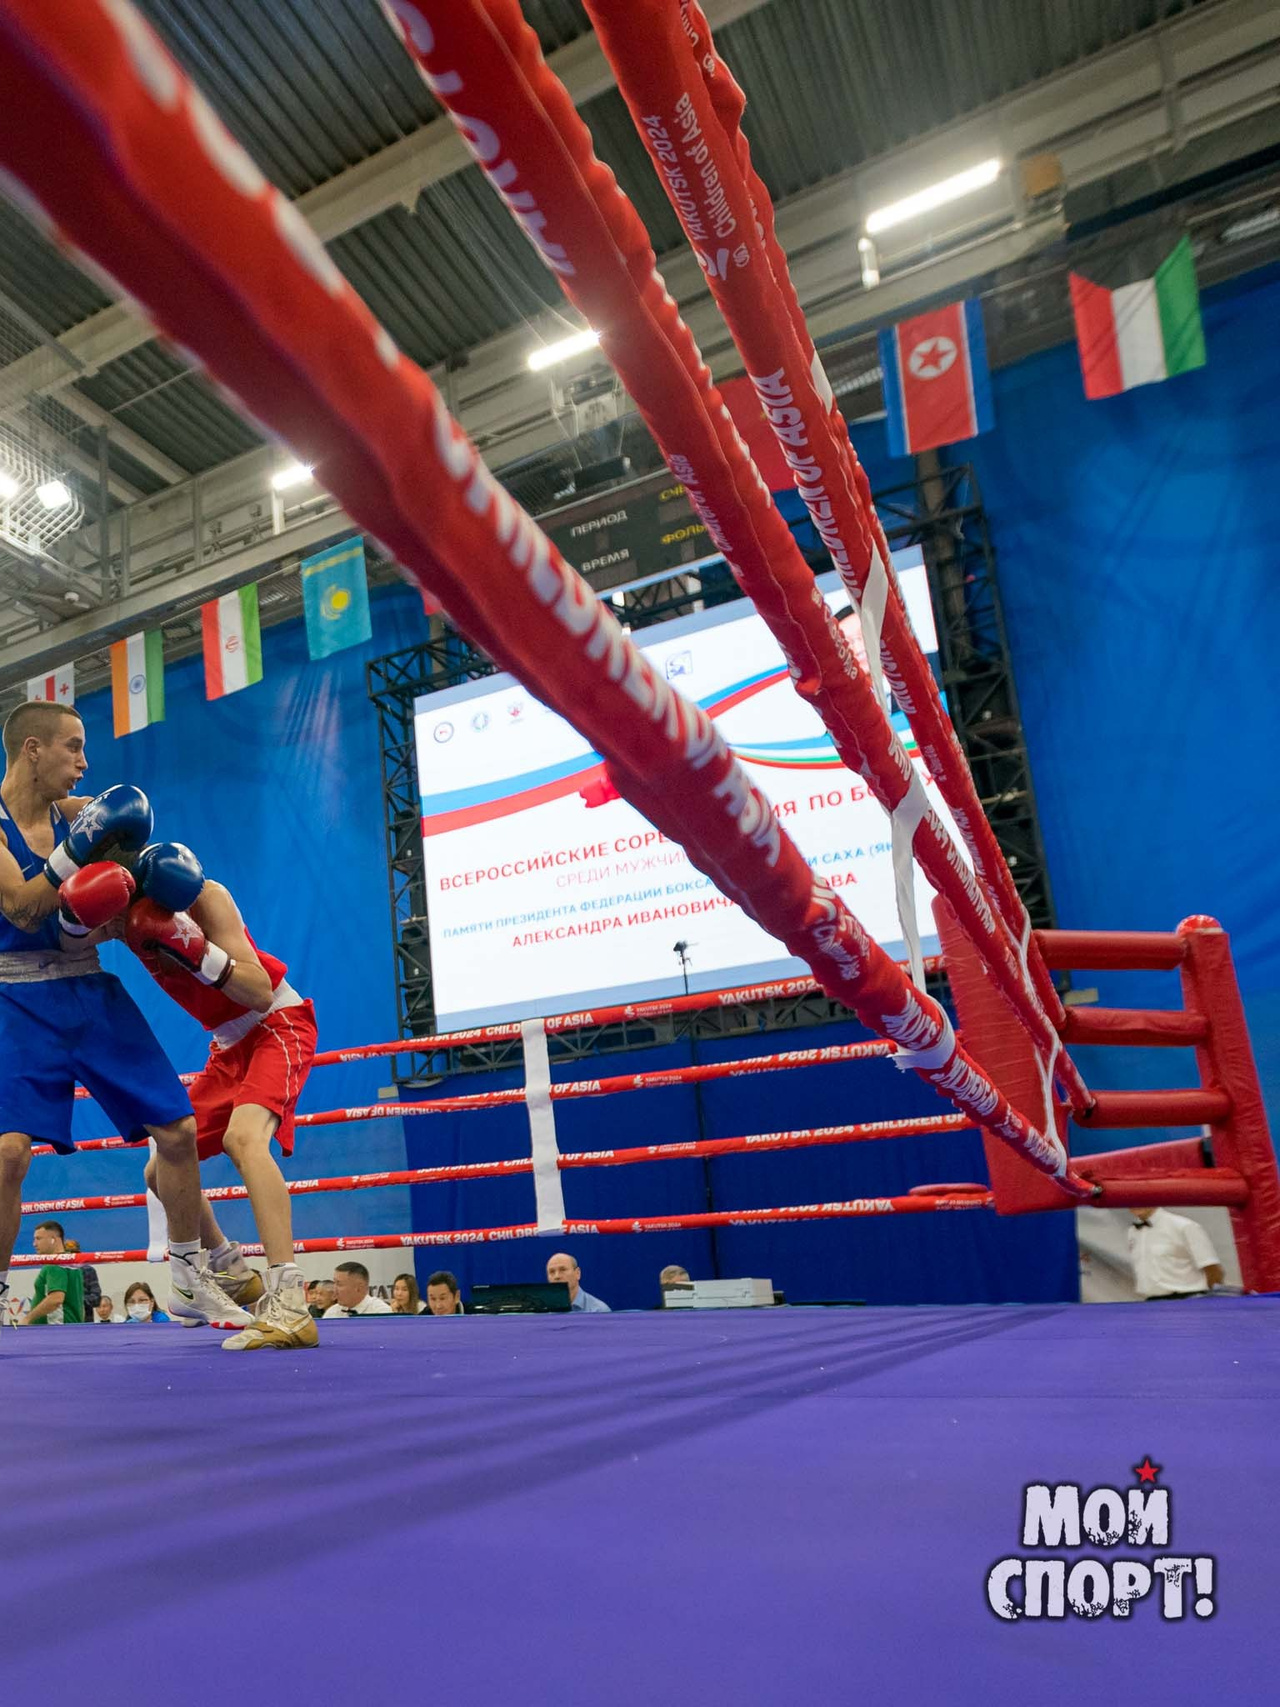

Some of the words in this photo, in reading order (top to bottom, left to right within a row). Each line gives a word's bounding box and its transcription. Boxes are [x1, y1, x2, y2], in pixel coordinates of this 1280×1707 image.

[674, 91, 701, 142] Asia
[641, 116, 677, 162] 2024
[699, 159, 736, 237] Children
[750, 366, 808, 445] ASIA
[571, 509, 628, 537] ПЕРИОД
[582, 548, 630, 573] ВРЕМЯ
[440, 842, 609, 891] ВСЕРОССИЙСКИЕ
[555, 866, 611, 889] СРЕДИ
[443, 920, 493, 938] ПАМЯТИ
[496, 904, 578, 929] ПРЕЗИДЕНТА
[580, 887, 663, 912] ФЕДЕРАЦИИ
[822, 848, 865, 864] САХА
[512, 918, 622, 948] АЛЕКСАНДРА
[718, 985, 783, 1005] YAKUTSK
[547, 1017, 563, 1029] OF
[563, 1012, 595, 1026] ASIA
[821, 1043, 893, 1060] YAKUTSK
[571, 1080, 601, 1093] ASIA
[66, 1199, 86, 1209] ASIA
[400, 1233, 452, 1246] YAKUTSK
[453, 1231, 485, 1243] 2024
